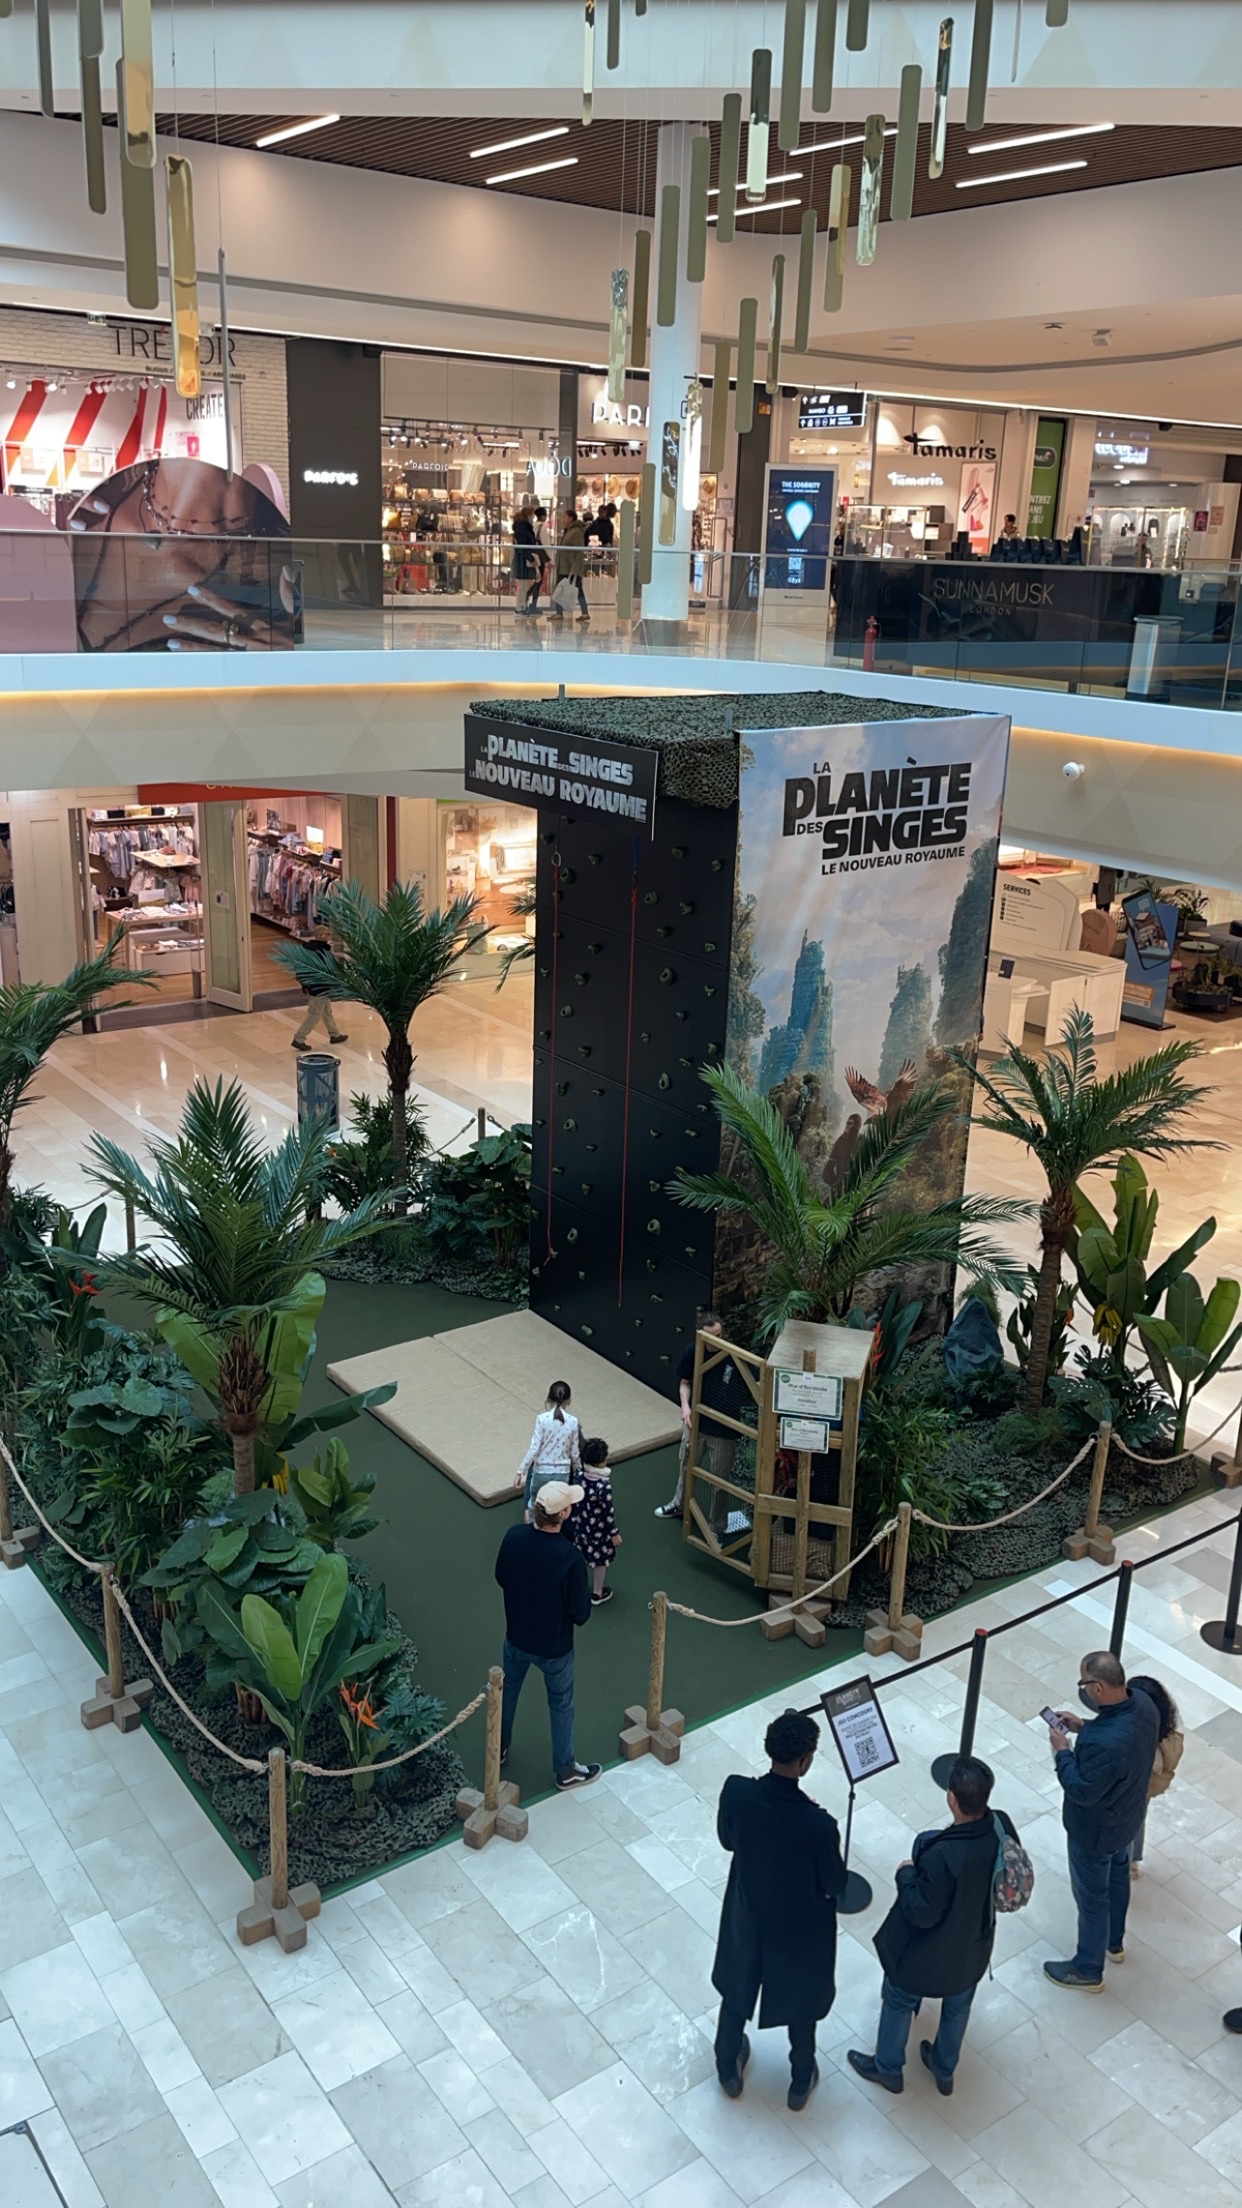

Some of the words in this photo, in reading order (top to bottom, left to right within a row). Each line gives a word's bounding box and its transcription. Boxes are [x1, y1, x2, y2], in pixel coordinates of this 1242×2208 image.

[107, 325, 236, 367] TRÉOR
[146, 365, 169, 374] BIJOUX
[1030, 494, 1052, 504] NTREZ
[933, 577, 1055, 605] SUNNAMUSK
[970, 605, 1011, 616] LONDON
[487, 734, 559, 769] PLANÈTE
[569, 751, 633, 786] SINGES
[813, 761, 832, 774] LA
[475, 759, 556, 797] NOUVEAU
[559, 779, 648, 821] ROYAUME
[782, 756, 972, 837] PLANÈTE
[796, 821, 823, 836] DES
[822, 805, 968, 860] SINGES
[821, 862, 837, 876] LE
[839, 854, 902, 873] NOUVEAU
[905, 846, 966, 865] ROYAUME
[1003, 884, 1031, 896] SERVICES
[846, 1707, 873, 1722] CONCOURS
